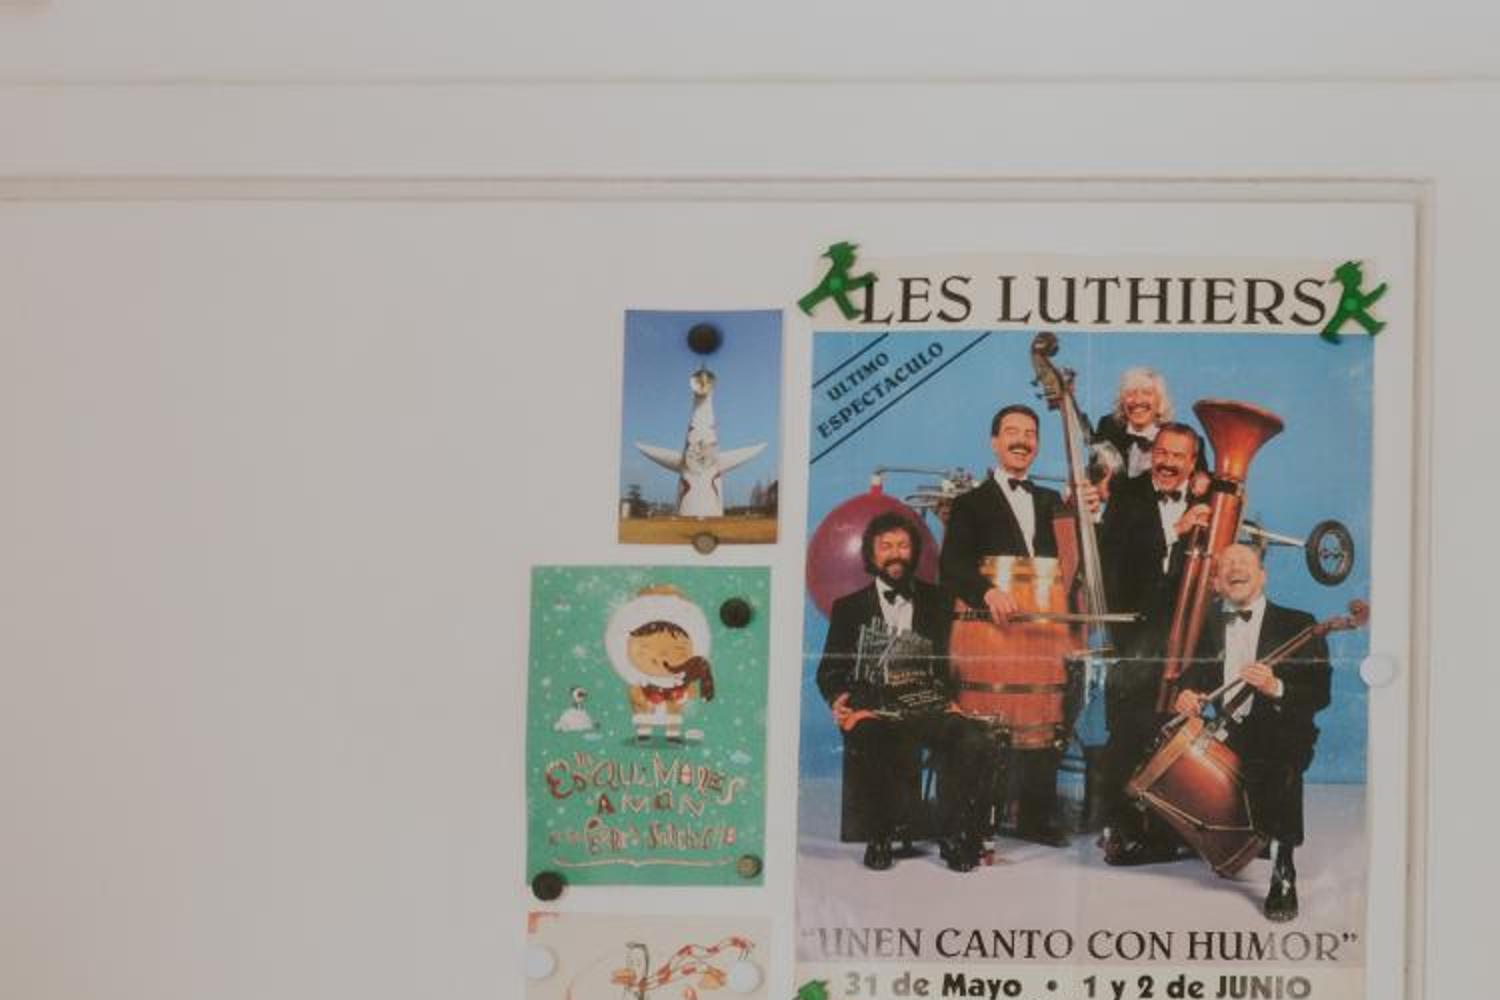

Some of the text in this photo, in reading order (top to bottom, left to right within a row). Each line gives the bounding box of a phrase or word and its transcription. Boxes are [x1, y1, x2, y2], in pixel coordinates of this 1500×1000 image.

[860, 275, 1326, 326] LES LUTHIERS
[817, 342, 943, 438] ESPECTACULO
[826, 352, 889, 401] ULTIMO
[935, 927, 1073, 960] CANTO
[1087, 930, 1175, 961] CON
[1186, 931, 1358, 961] HUMOR”
[845, 971, 877, 996] 31
[893, 972, 930, 997] de
[942, 973, 1022, 1000] Mayo
[1083, 975, 1096, 998] 1
[1137, 975, 1155, 998] 2
[1166, 974, 1205, 999] de
[1216, 975, 1312, 1000] JUNIO
